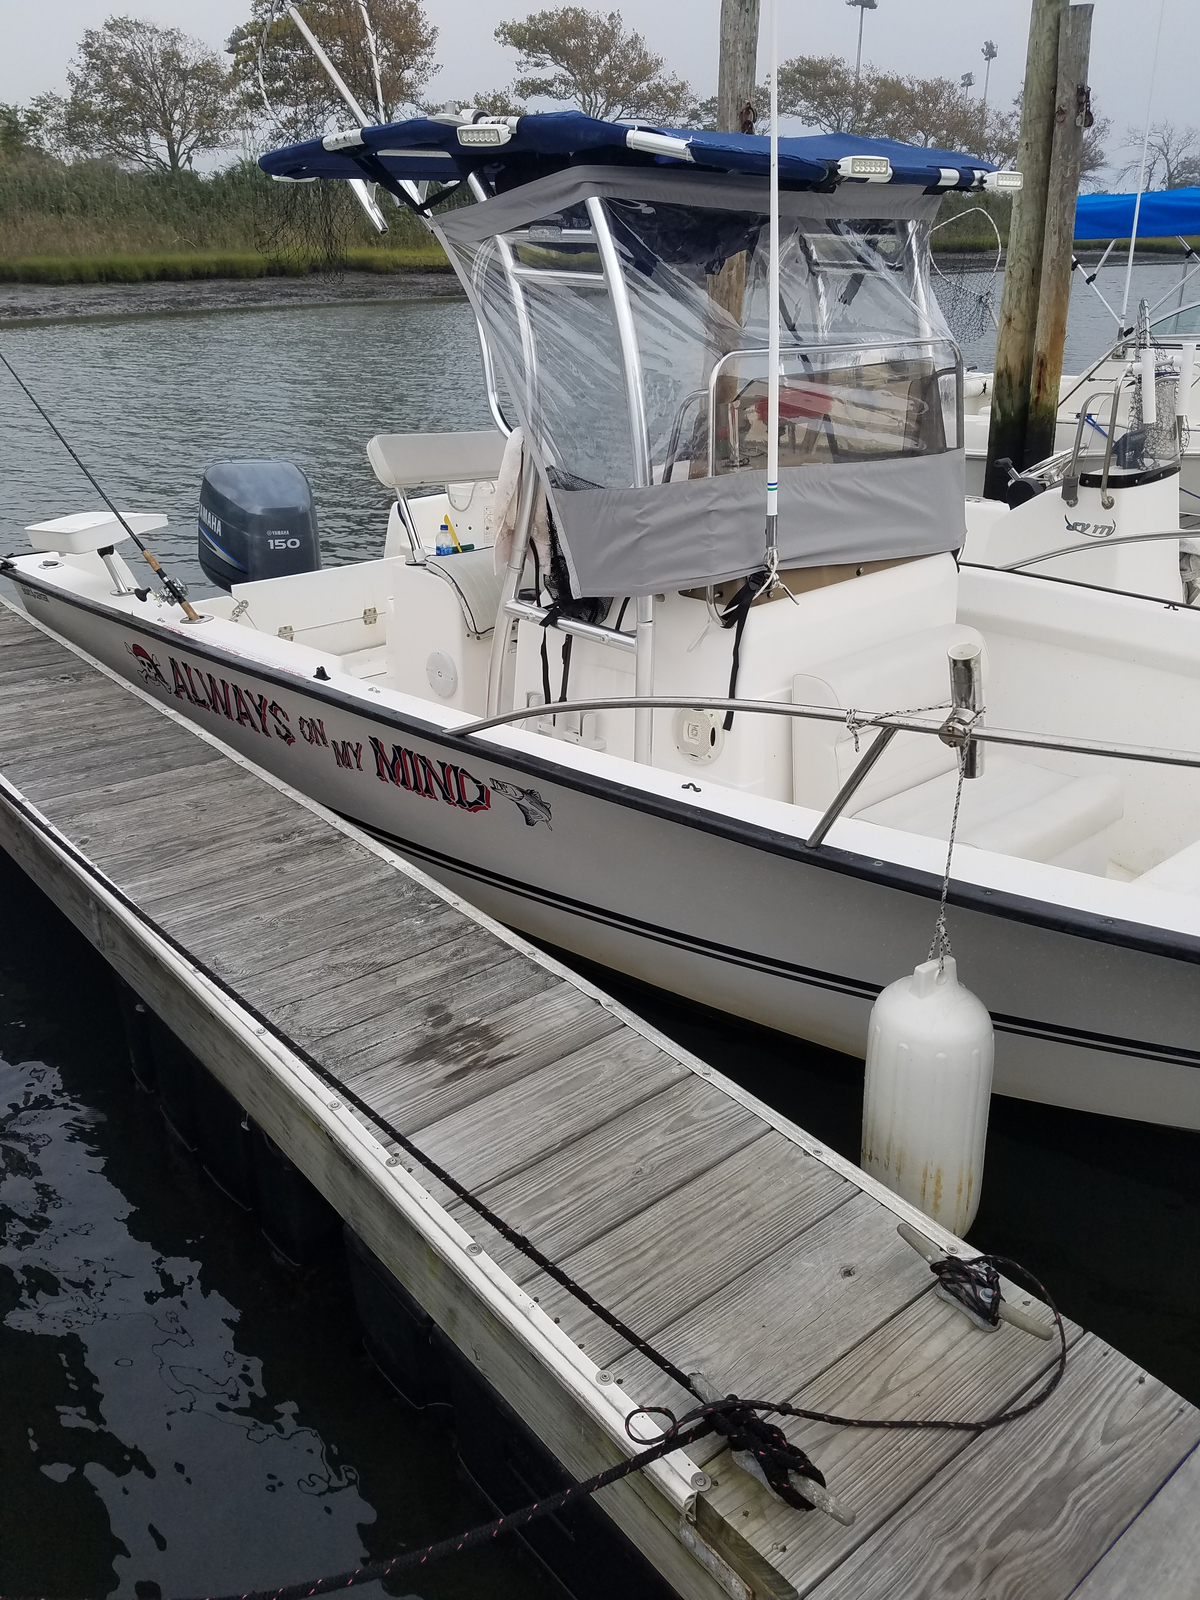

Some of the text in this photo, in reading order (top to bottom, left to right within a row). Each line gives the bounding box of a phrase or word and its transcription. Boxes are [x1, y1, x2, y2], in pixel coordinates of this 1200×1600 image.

[267, 538, 301, 550] 150
[168, 656, 491, 813] ALWAYS ON MY MIND
